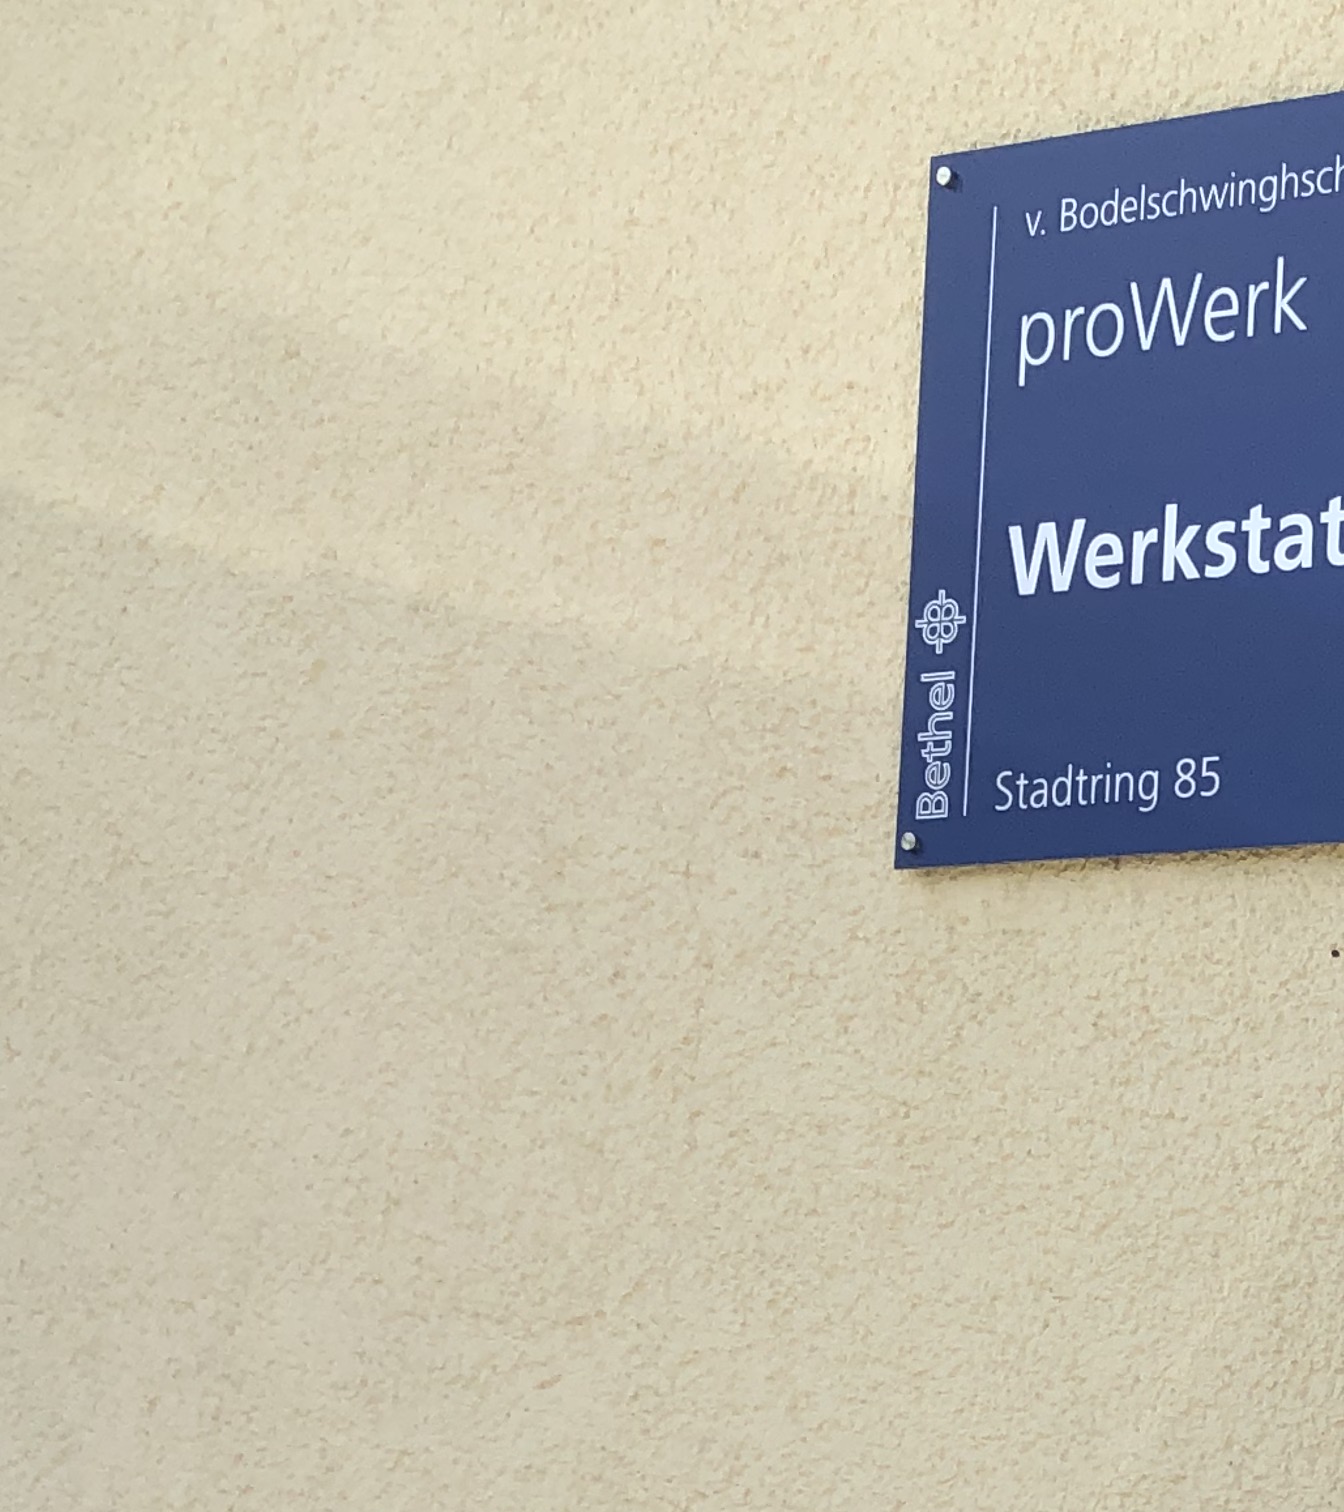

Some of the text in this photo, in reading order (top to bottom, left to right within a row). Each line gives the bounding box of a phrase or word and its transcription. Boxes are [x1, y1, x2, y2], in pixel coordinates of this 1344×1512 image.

[1025, 210, 1046, 237] v.
[1018, 256, 1307, 387] proWerk
[915, 670, 956, 820] Bethel
[995, 756, 1220, 812] Stadtring 85
